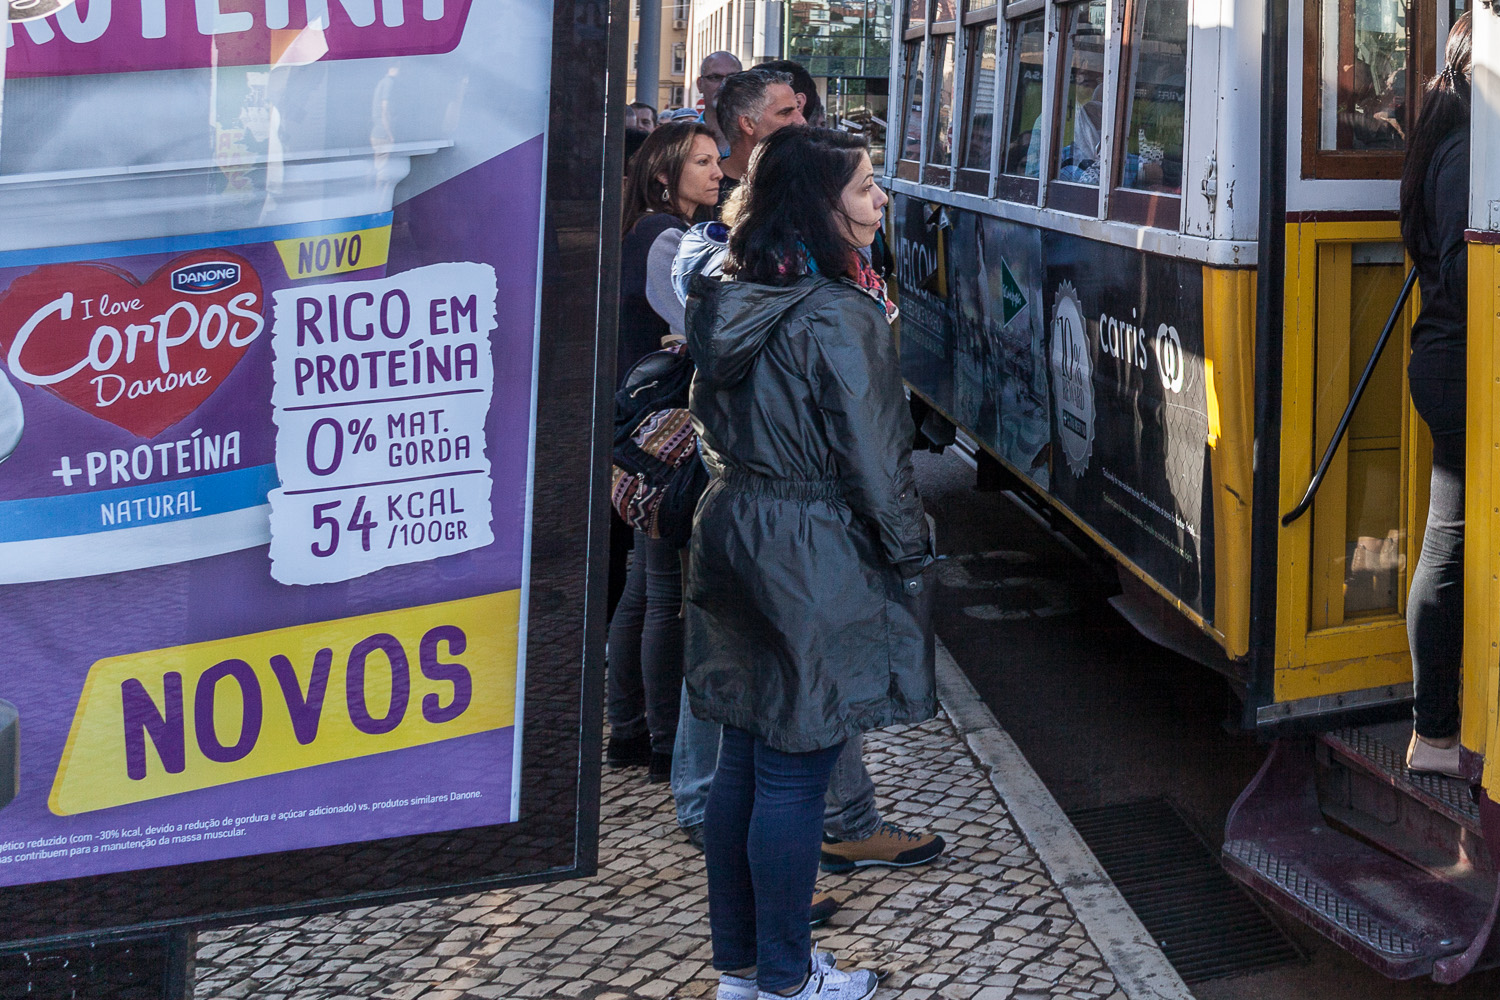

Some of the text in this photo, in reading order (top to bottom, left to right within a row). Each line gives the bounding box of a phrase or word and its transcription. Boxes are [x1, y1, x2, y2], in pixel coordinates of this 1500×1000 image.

[298, 234, 362, 275] NOVO
[81, 294, 145, 320] I love
[296, 288, 478, 347] RICO EM
[1099, 307, 1148, 370] carris
[91, 368, 211, 407] Danone
[295, 340, 478, 395] PROTEÍNA
[388, 409, 450, 440] MAT.
[51, 429, 242, 488] +PROTEÍNA
[305, 417, 377, 477] 0%
[388, 436, 470, 468] GORDA
[101, 491, 202, 526] NATURAL
[388, 487, 465, 522] KCAL
[310, 495, 378, 559] 54
[387, 520, 468, 550] /100GR
[121, 625, 473, 781] NOVOS
[26, 835, 68, 849] reduzido
[69, 834, 93, 845] (com
[95, 829, 120, 841] -30%
[121, 826, 143, 838] kcal,
[145, 823, 175, 836] devido
[184, 818, 220, 830] redução
[222, 817, 233, 826] de
[235, 813, 269, 827] gordura
[278, 809, 307, 821] açúcar
[308, 803, 357, 817] adicionado)
[358, 803, 370, 811] vs.
[372, 799, 409, 812] produtos
[410, 794, 449, 806] similares
[449, 790, 483, 801] Danone.
[14, 849, 68, 862] contribuem
[69, 846, 91, 858] para
[100, 838, 157, 853] manutenção
[158, 836, 170, 846] da
[171, 834, 202, 844] massa
[203, 827, 247, 841] muscular.
